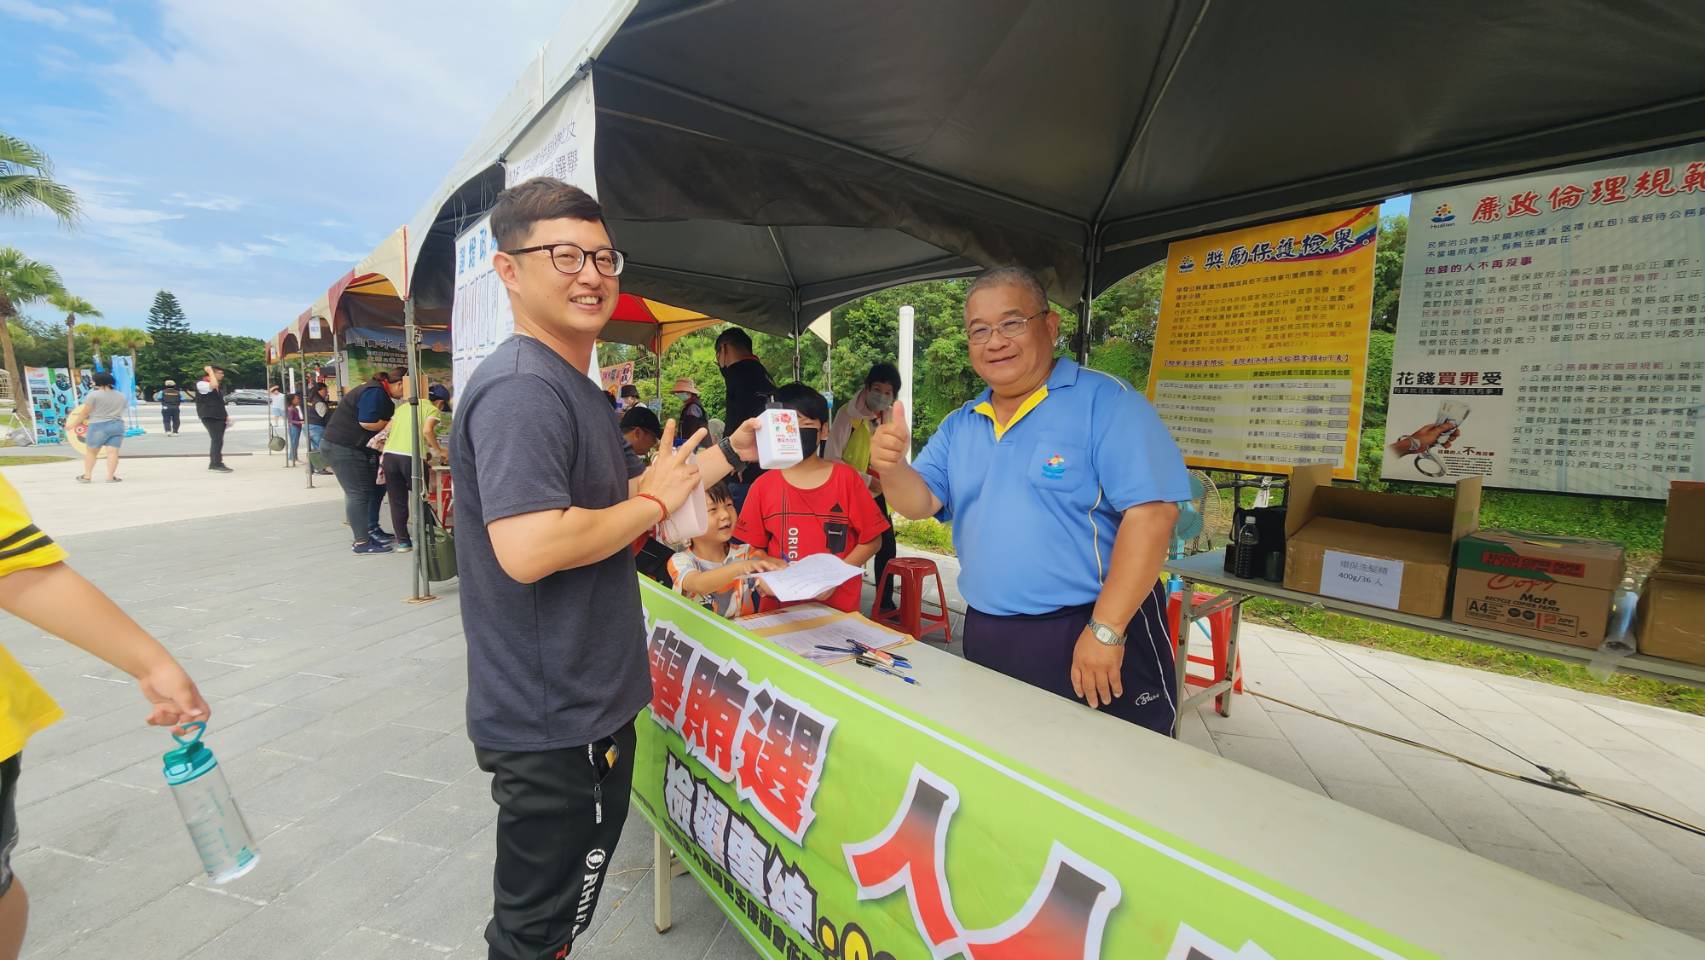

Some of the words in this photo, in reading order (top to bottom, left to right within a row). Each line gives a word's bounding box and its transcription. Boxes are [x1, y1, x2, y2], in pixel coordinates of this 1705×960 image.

[1471, 162, 1705, 223] 廉政倫理規範
[1396, 371, 1502, 386] 花錢買罪受
[1468, 599, 1489, 614] A4
[1520, 593, 1557, 606] Mate
